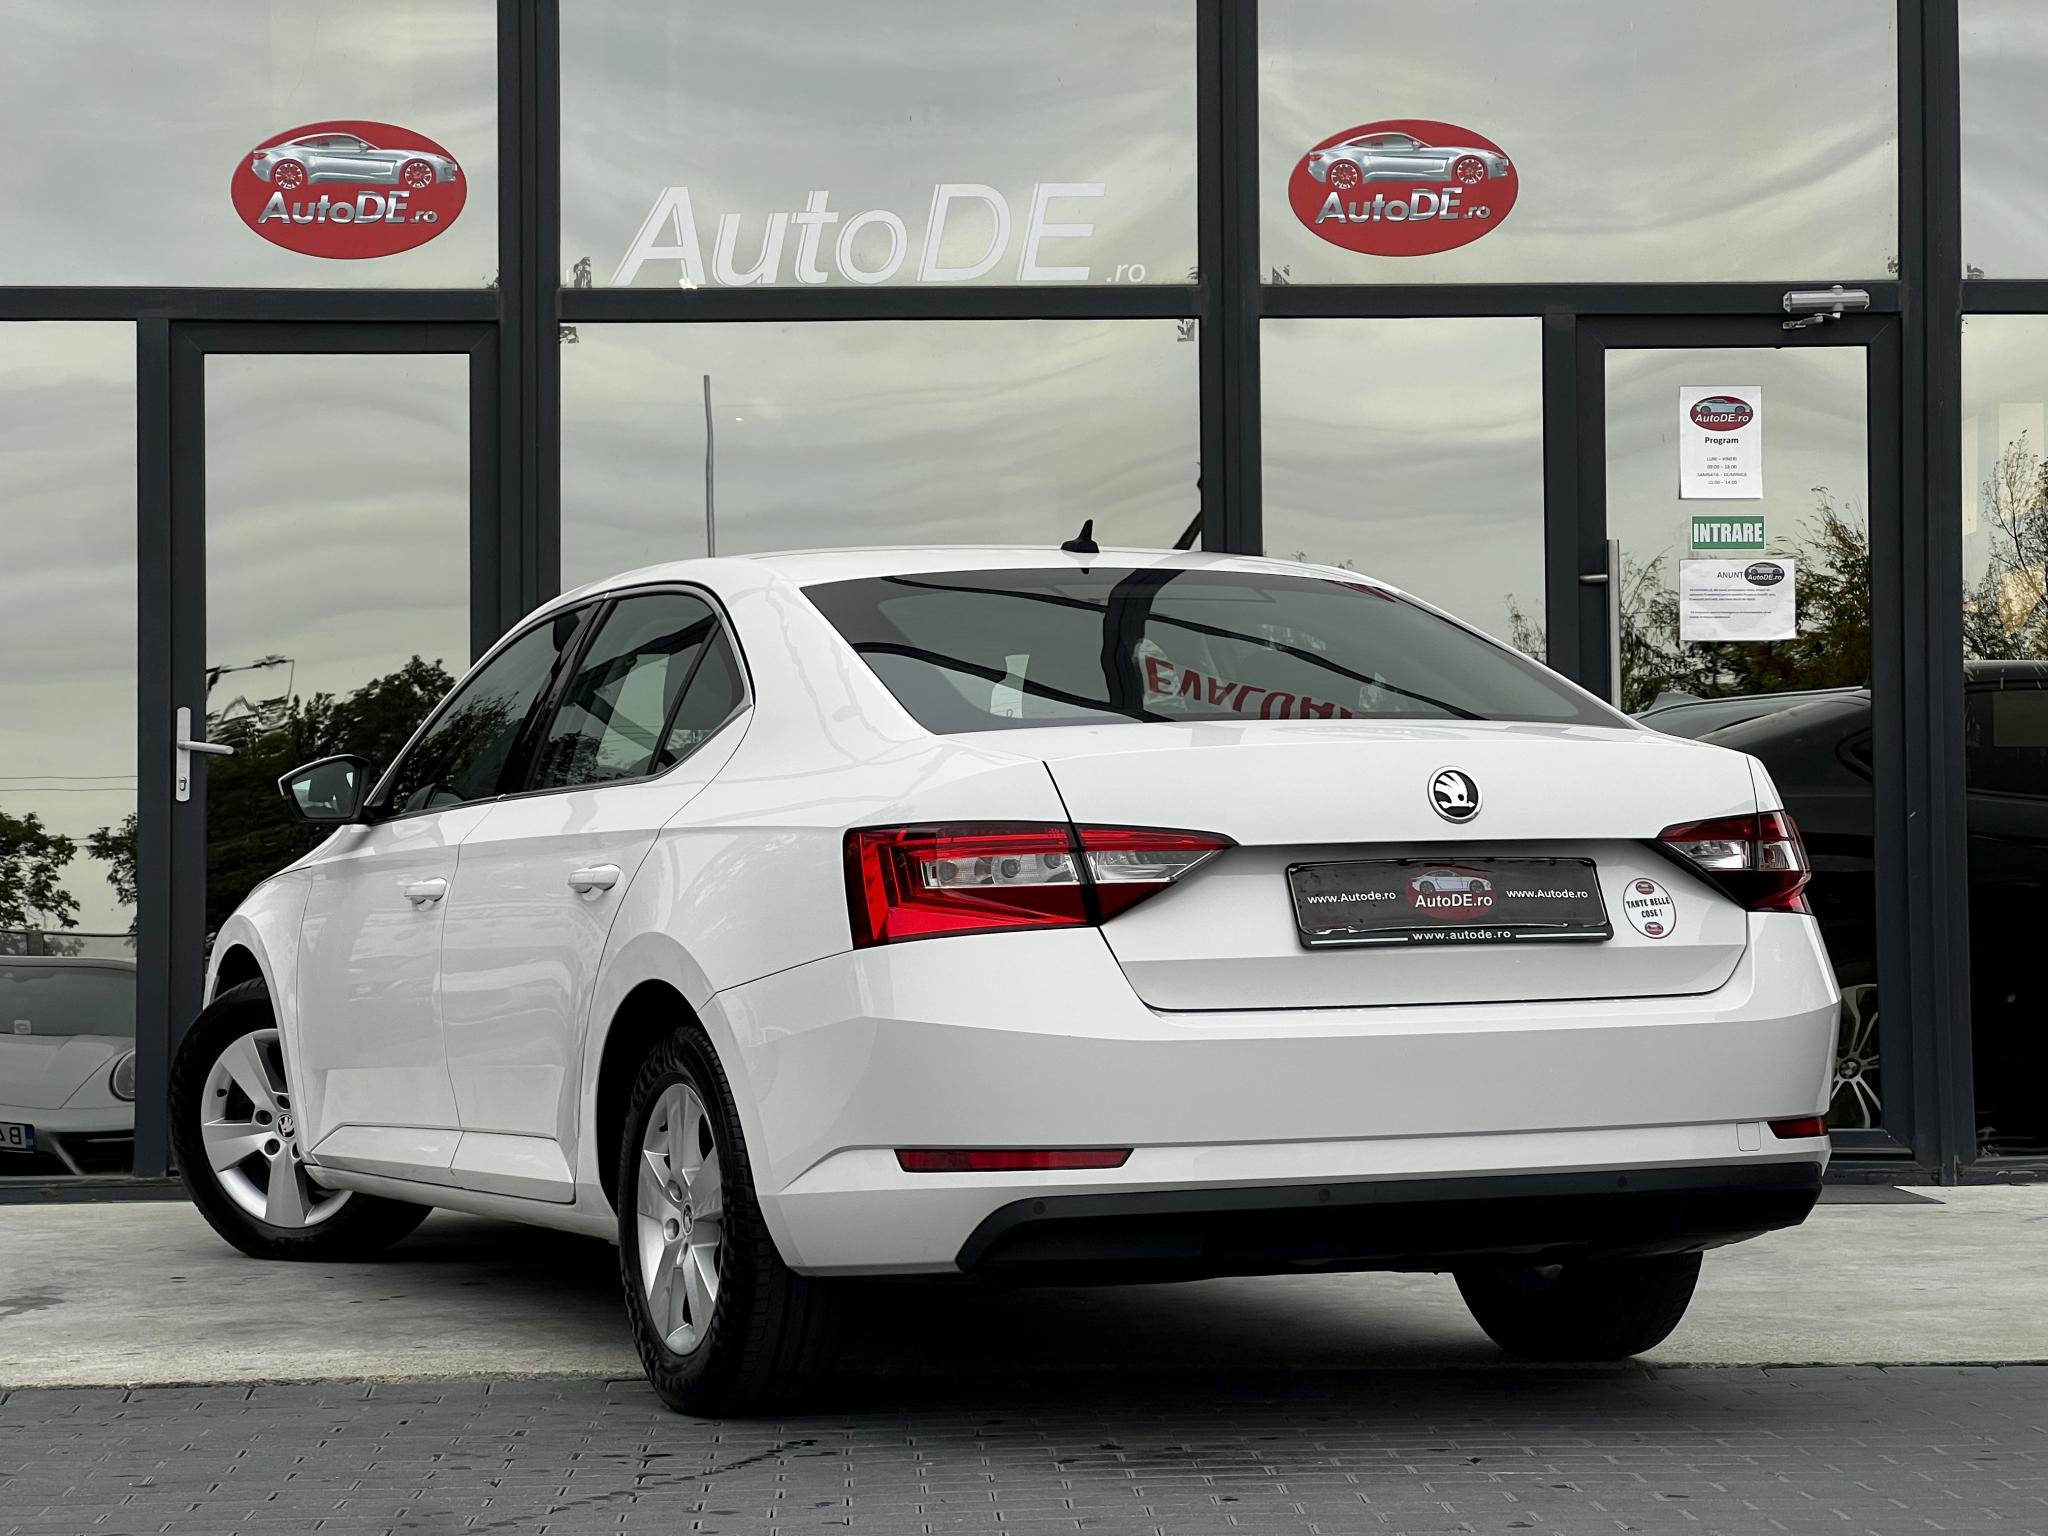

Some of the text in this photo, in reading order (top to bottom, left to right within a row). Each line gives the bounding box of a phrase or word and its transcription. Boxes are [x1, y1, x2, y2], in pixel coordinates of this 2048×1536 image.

[1695, 413, 1750, 423] AutoDE.ro
[1704, 437, 1739, 446] Program
[1693, 522, 1763, 543] INTRARE
[1747, 573, 1783, 581] AutoDE.ro
[1306, 890, 1397, 905] www.Autode.ro
[1506, 889, 1589, 899] www.Autode.ro
[1415, 893, 1493, 908] AutoDE.ro
[1625, 896, 1671, 909] TANTE BELLE
[1641, 909, 1658, 918] COSE
[1412, 930, 1512, 941] www.autode.ro
